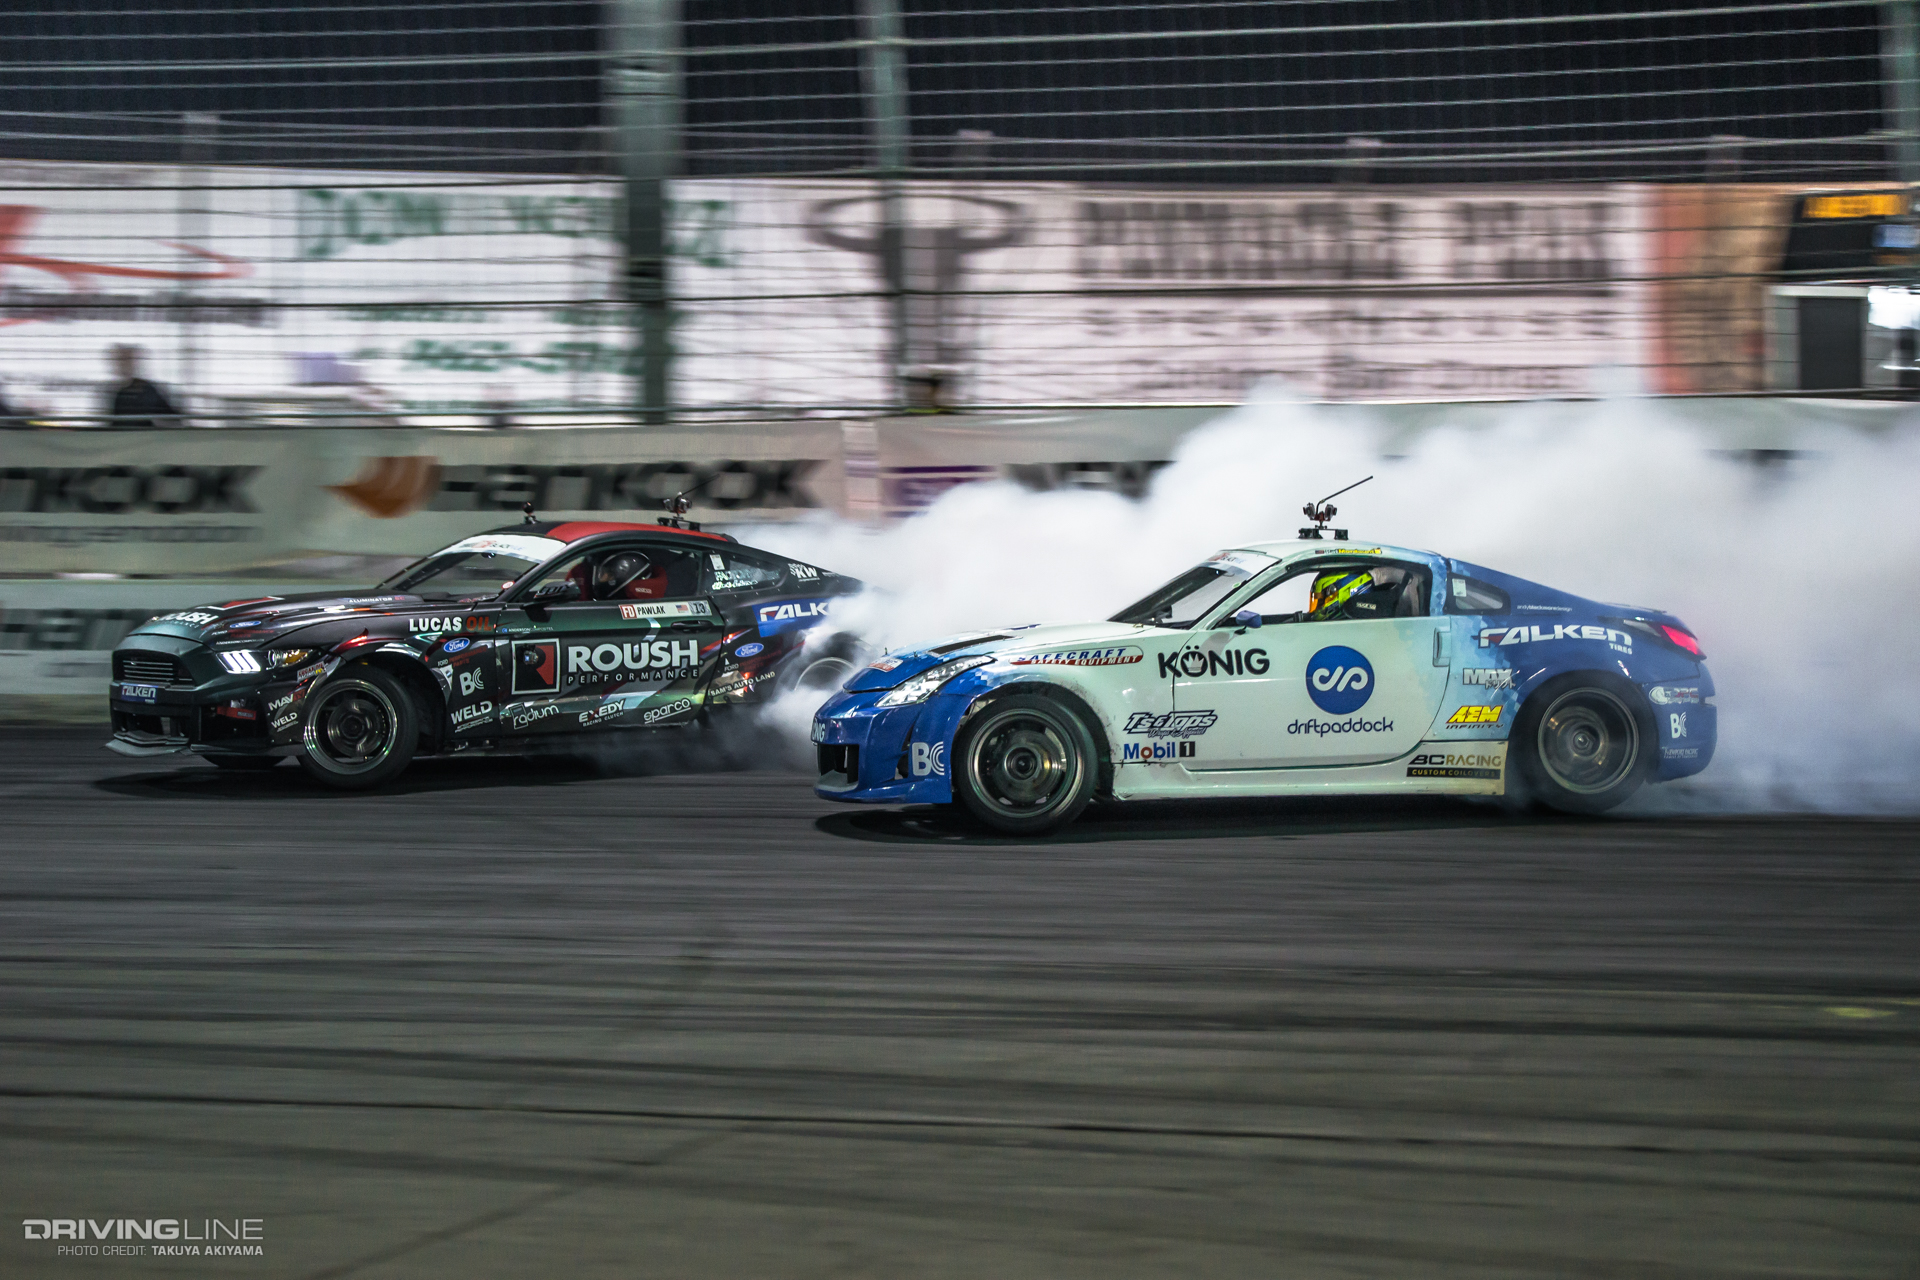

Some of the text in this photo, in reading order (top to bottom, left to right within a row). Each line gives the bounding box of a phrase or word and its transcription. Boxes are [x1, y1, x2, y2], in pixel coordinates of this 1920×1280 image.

[795, 567, 818, 579] KW
[623, 603, 706, 618] FD PAWLAK 13
[760, 602, 829, 622] FALK
[409, 616, 493, 632] LUCAS OIL
[1479, 624, 1633, 649] FALKEN
[568, 640, 699, 672] ROUSH
[1017, 648, 1126, 662] SAFECRAFT
[1609, 643, 1633, 655] TIRES
[1074, 655, 1138, 666] EQUIPMENT
[1158, 645, 1270, 678] KÖNIG
[459, 667, 485, 696] BC
[568, 669, 699, 684] PERFORMANCE
[710, 671, 776, 697] SAM'S AUTO LAND
[1463, 668, 1513, 685] MAX
[122, 685, 156, 698] FALKEN
[271, 712, 297, 728] WELD
[451, 701, 493, 724] WELD
[512, 704, 560, 727] radium
[578, 700, 625, 723] EXEDY
[582, 711, 624, 727] RACING CLUTCH
[1445, 705, 1503, 724] AEM
[1287, 716, 1394, 738] driftpaddock
[1670, 711, 1687, 739] BC
[912, 741, 945, 776] BC
[1124, 742, 1176, 760] Mobil
[1448, 769, 1495, 778] COILOVERS
